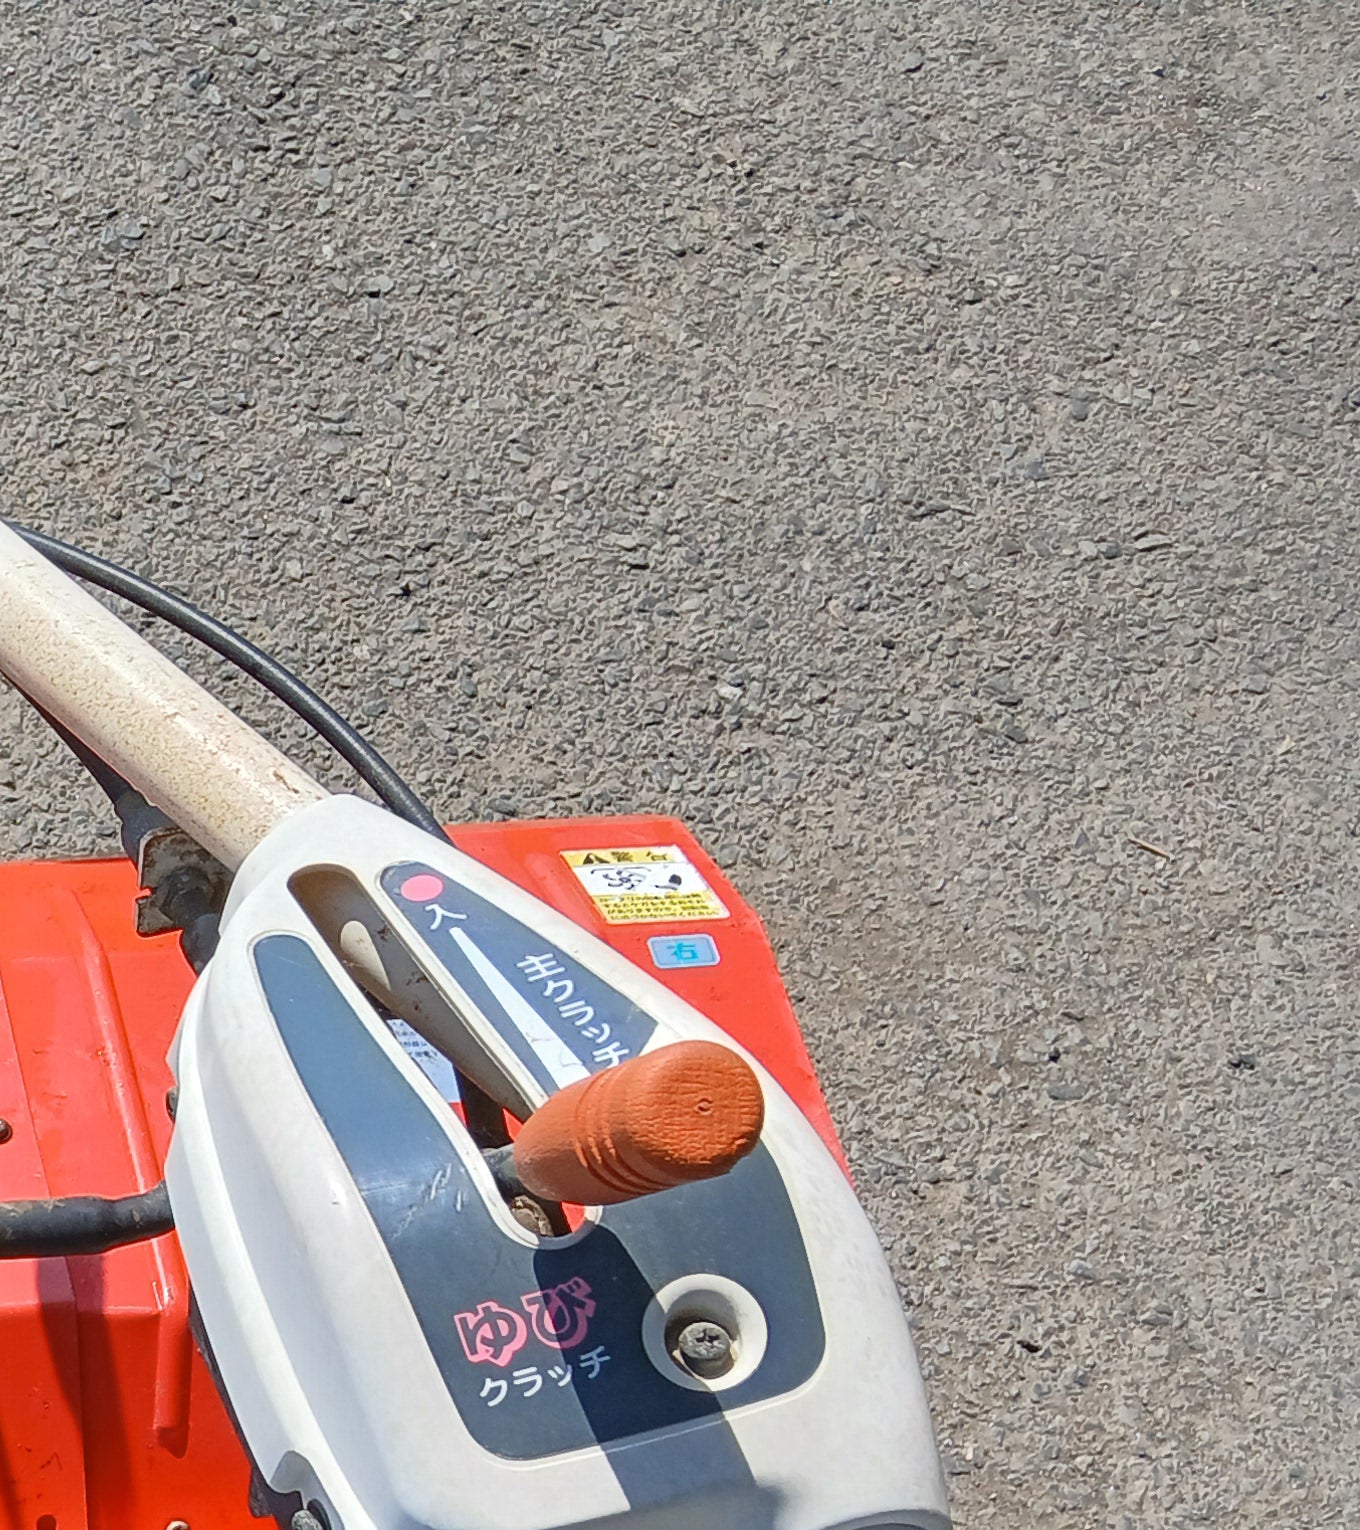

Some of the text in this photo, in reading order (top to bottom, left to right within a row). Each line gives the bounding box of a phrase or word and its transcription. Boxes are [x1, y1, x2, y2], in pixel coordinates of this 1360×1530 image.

[425, 903, 468, 931] 入
[666, 942, 698, 962] 右
[453, 1276, 597, 1368] ゆび
[480, 1346, 611, 1407] クラッチ
